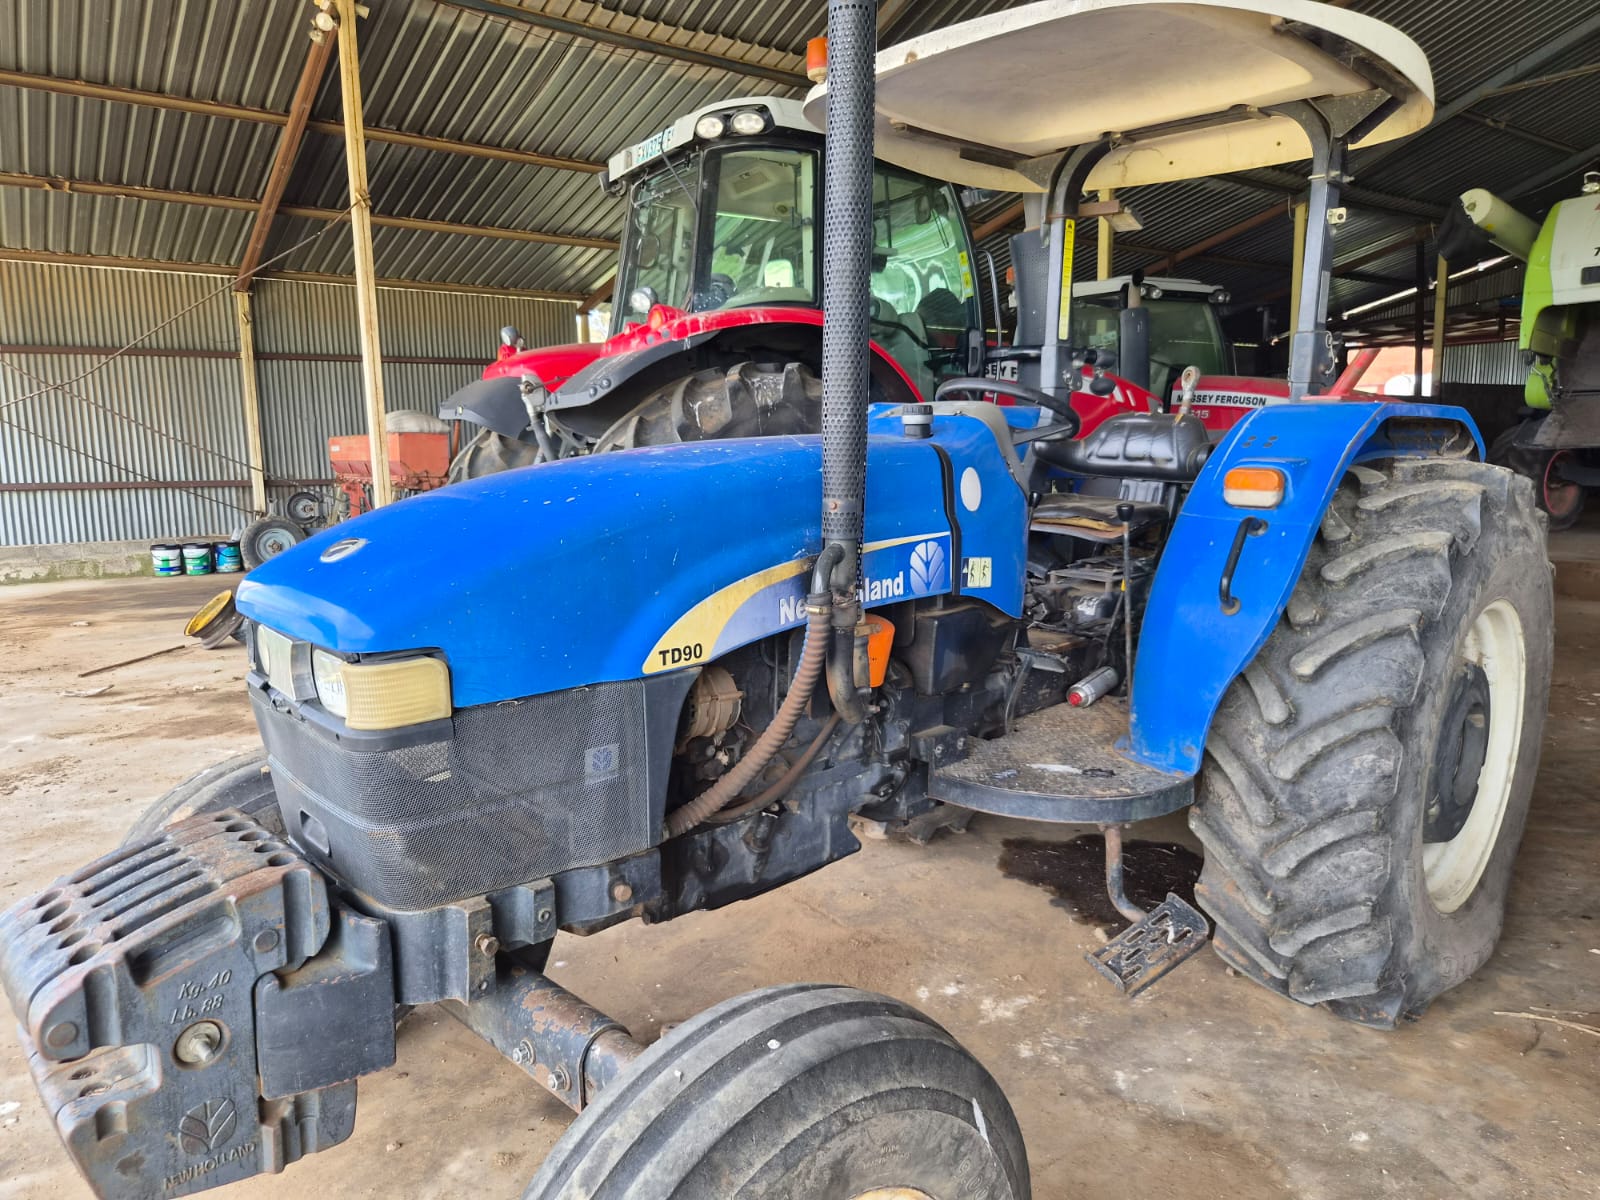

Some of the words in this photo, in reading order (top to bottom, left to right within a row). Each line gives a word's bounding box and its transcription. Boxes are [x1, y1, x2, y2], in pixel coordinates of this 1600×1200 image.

[1176, 394, 1213, 405] MSSEY
[1214, 396, 1267, 407] FERGUSON
[779, 596, 809, 625] Ne
[658, 643, 703, 666] TD90
[194, 1141, 257, 1177] HOLLAND
